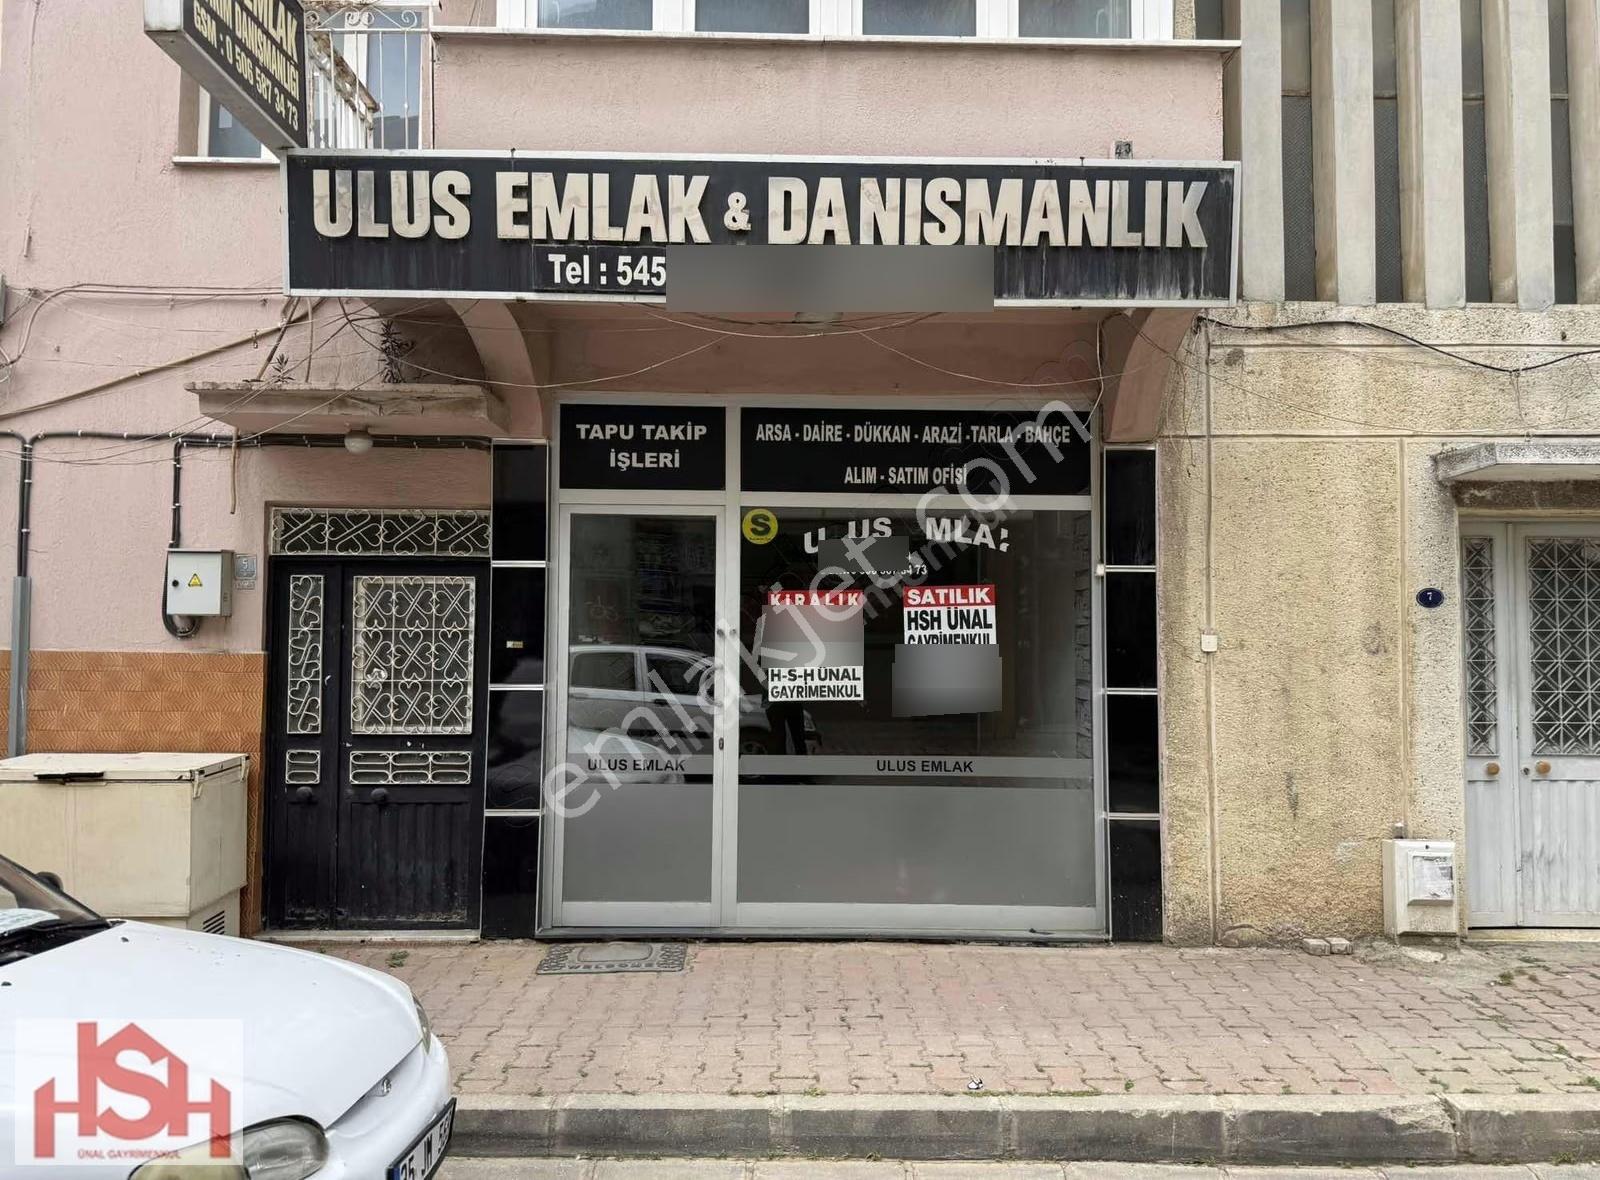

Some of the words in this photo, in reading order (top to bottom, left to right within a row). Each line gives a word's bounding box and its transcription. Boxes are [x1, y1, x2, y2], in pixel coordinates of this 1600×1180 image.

[193, 0, 217, 49] GSM
[226, 35, 233, 65] 0
[234, 44, 254, 86] 506
[255, 66, 272, 104] 587
[274, 87, 286, 119] 34
[286, 99, 299, 131] 73
[312, 169, 471, 240] ULUS
[495, 171, 711, 244] EMLAK
[724, 191, 752, 231] &
[548, 254, 590, 284] Tel
[600, 263, 607, 285] :
[616, 255, 666, 287] 545
[576, 424, 634, 440] TAPU
[642, 421, 707, 440] TAKİP
[756, 424, 792, 441] ARSA
[803, 420, 843, 442] DAİRE
[854, 421, 911, 443] DÜKKAN
[922, 422, 962, 443] ARAZİ
[1025, 425, 1070, 448] BAHÇE
[609, 449, 680, 472] İŞLERİ
[844, 466, 877, 484] ALIM
[888, 467, 928, 485] SATIM
[933, 463, 968, 485] OFİSİ
[750, 514, 771, 536] S
[907, 587, 992, 605] SATILIK
[907, 610, 942, 631] HSH
[946, 607, 993, 630] ÜNAL
[770, 668, 814, 682] H-S-H
[818, 667, 861, 682] ÜNAL
[771, 682, 861, 699] GAYRİMENKUL
[588, 759, 628, 771] ULUS
[633, 759, 685, 772] EMLAK
[876, 759, 916, 772] ULUS
[920, 759, 974, 773] EMLAK
